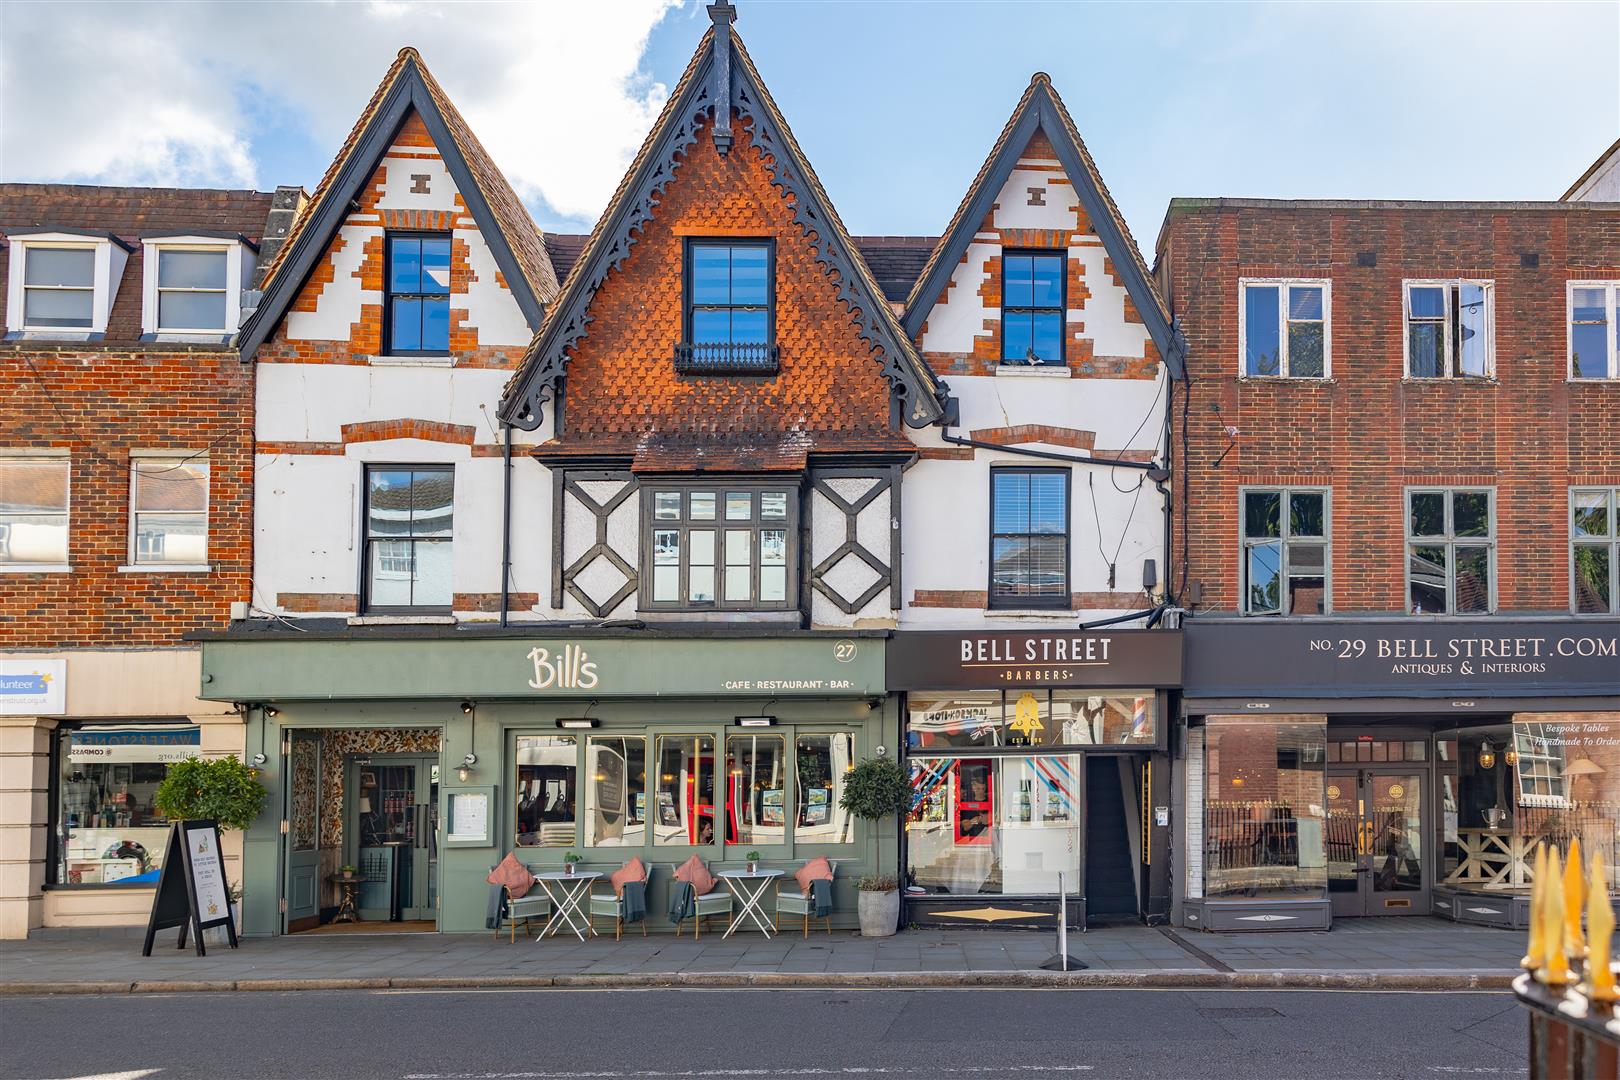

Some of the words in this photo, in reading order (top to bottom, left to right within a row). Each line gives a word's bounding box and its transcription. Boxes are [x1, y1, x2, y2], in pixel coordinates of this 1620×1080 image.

[836, 644, 855, 658] 27
[961, 639, 1016, 661] BELL
[1025, 638, 1111, 661] STREET
[1309, 640, 1334, 651] NO.
[1337, 639, 1367, 659] 29
[1377, 639, 1438, 658] BELL
[526, 644, 599, 689] Bill's
[1391, 663, 1453, 675] ANTIQUES
[1460, 660, 1475, 675] &
[1482, 662, 1546, 673] INTERIORS
[1006, 670, 1068, 681] BARBERS
[725, 680, 751, 690] CAFE
[757, 680, 823, 690] RESTAURANT
[830, 680, 850, 689] BAR
[1545, 723, 1580, 735] Bespoke
[1582, 723, 1610, 733] Tables
[1534, 737, 1581, 746] Handmade
[1583, 737, 1594, 746] To
[1596, 737, 1620, 746] Order
